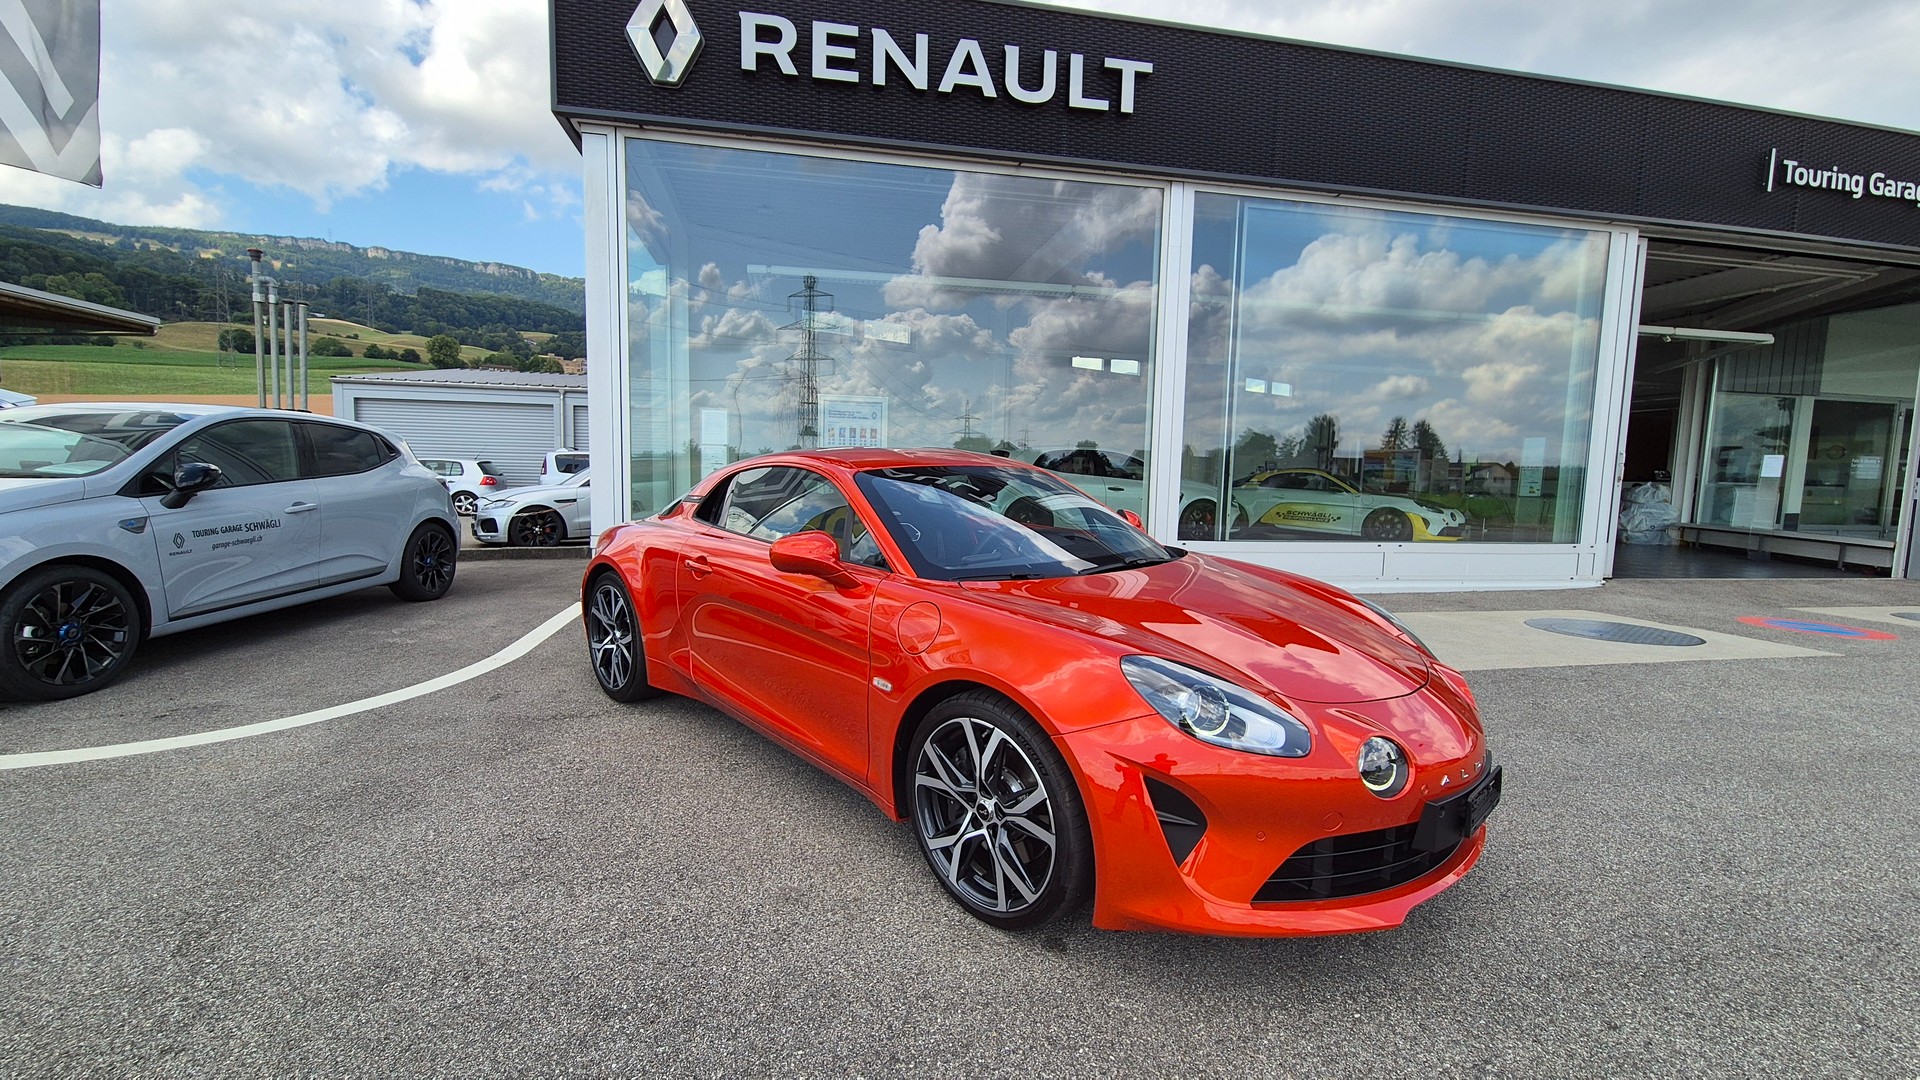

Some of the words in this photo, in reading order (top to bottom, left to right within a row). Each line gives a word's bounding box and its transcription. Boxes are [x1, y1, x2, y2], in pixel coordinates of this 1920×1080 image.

[738, 10, 1154, 114] RENAULT
[1783, 159, 1864, 199] Touring
[1869, 172, 1920, 208] Gara
[192, 526, 219, 538] TOURING
[220, 524, 243, 534] GARAGE
[244, 519, 281, 532] SCHWÄGLI
[211, 535, 263, 550] garage-schwaegli.ch
